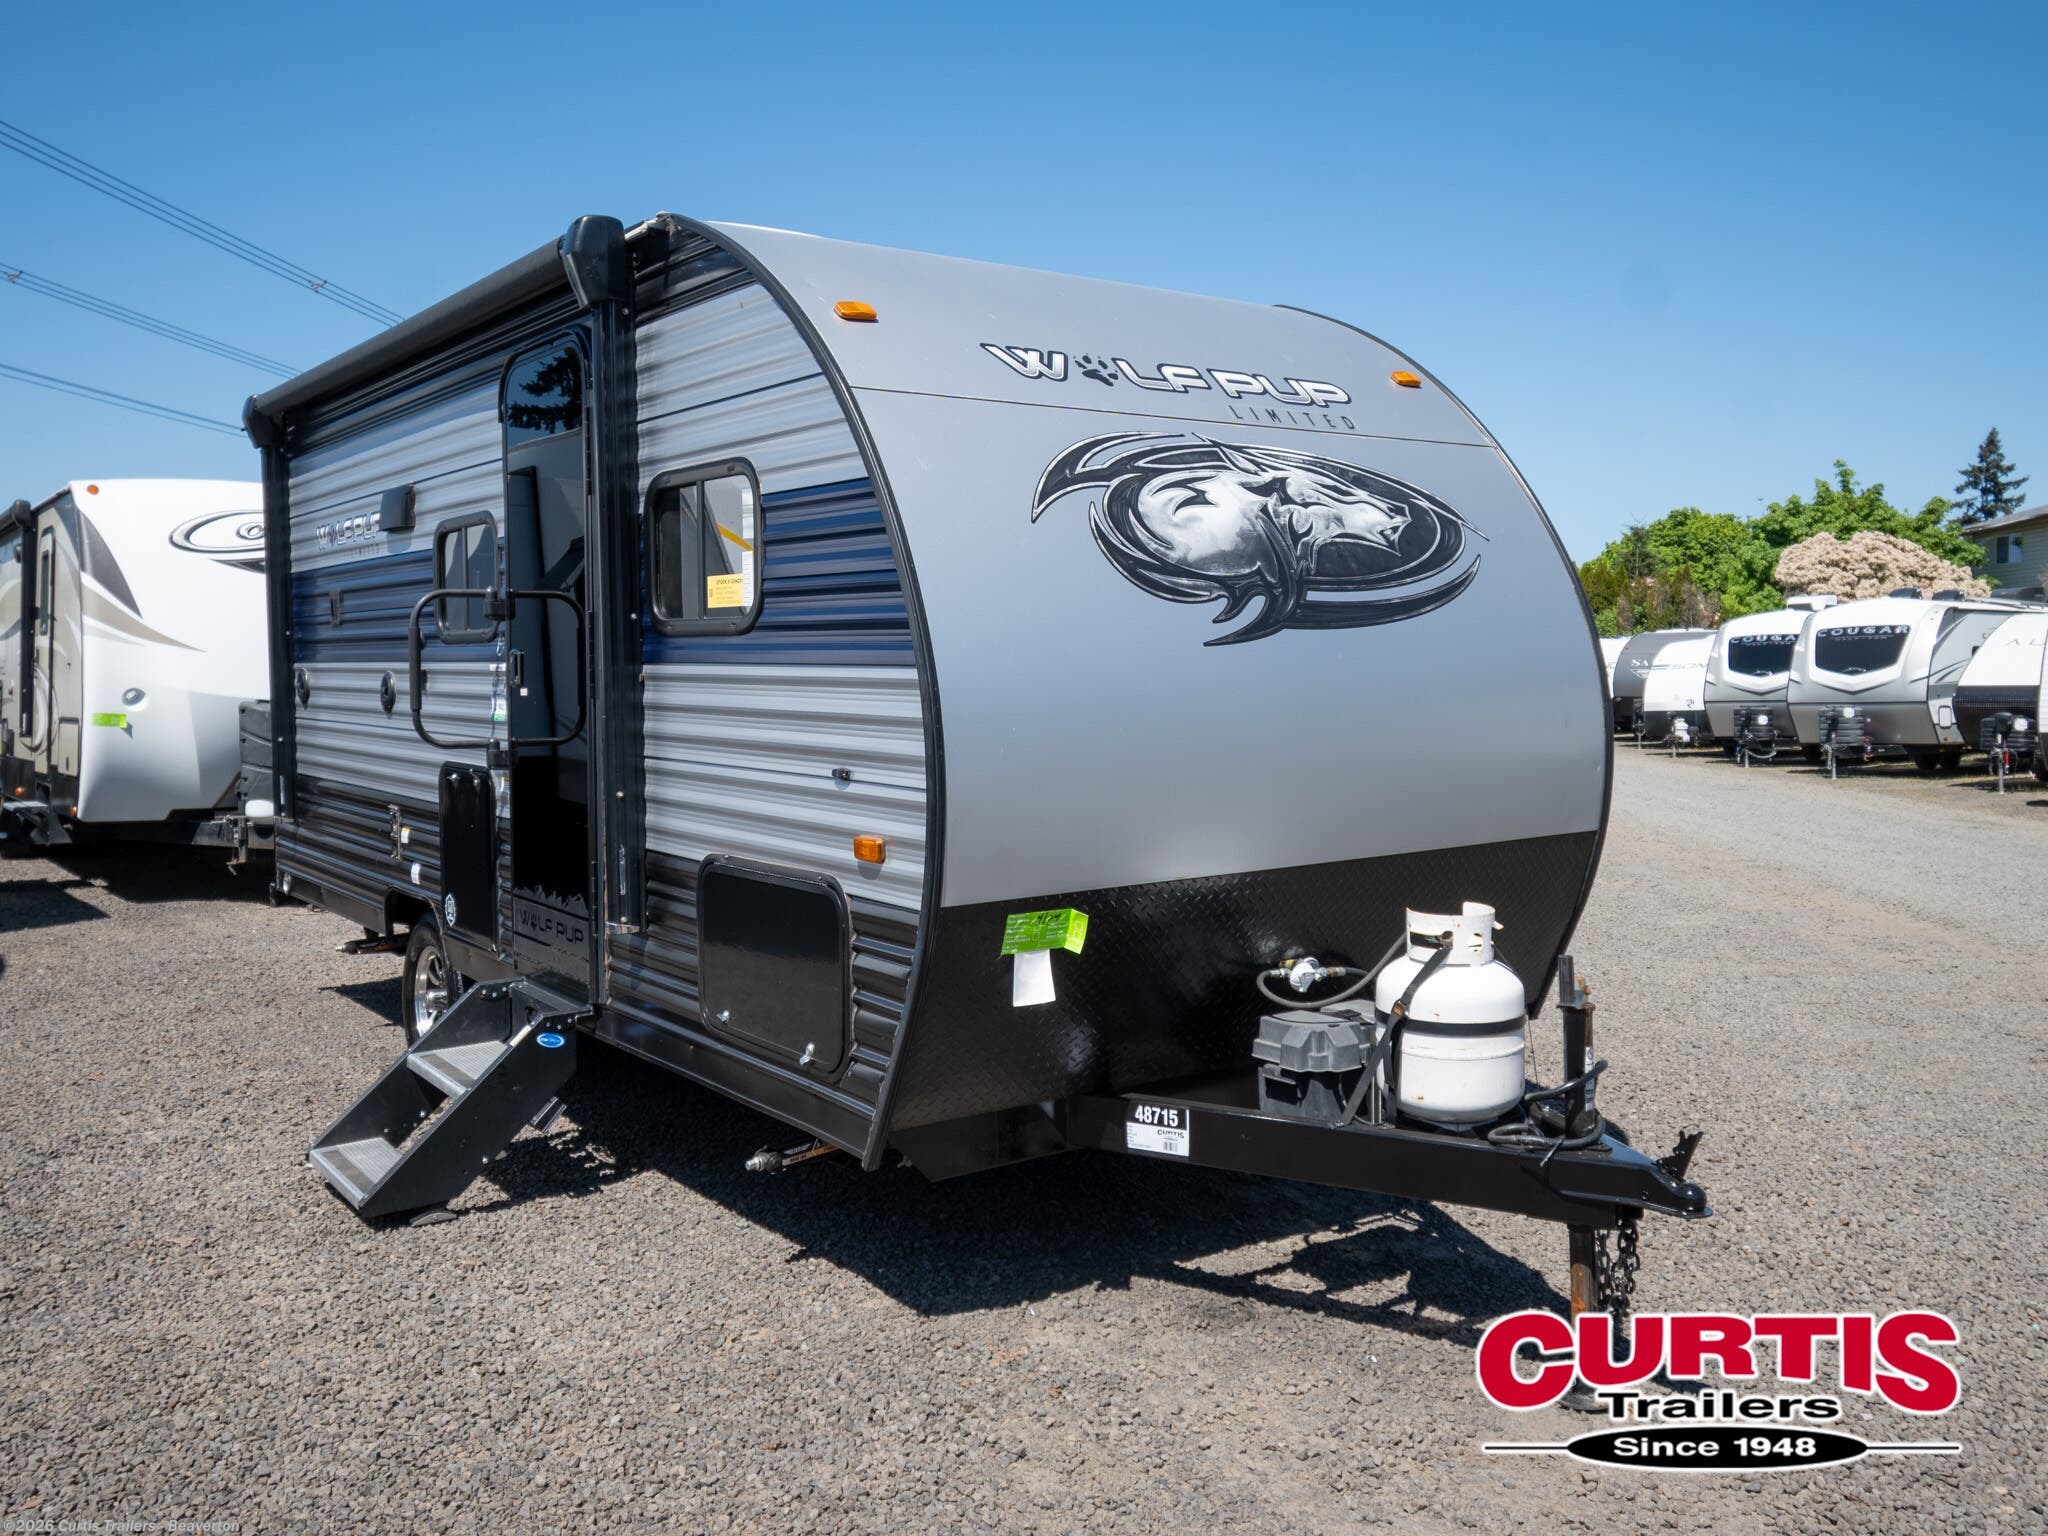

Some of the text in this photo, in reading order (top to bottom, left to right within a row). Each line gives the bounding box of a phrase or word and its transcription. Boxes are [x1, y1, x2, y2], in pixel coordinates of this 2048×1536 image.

[1206, 368, 1352, 408] PUP
[1230, 404, 1355, 430] LIMITED
[1730, 634, 1797, 645] COUGA
[1816, 625, 1910, 638] COUGAR
[556, 922, 584, 944] PUP
[1134, 1105, 1179, 1127] 48715
